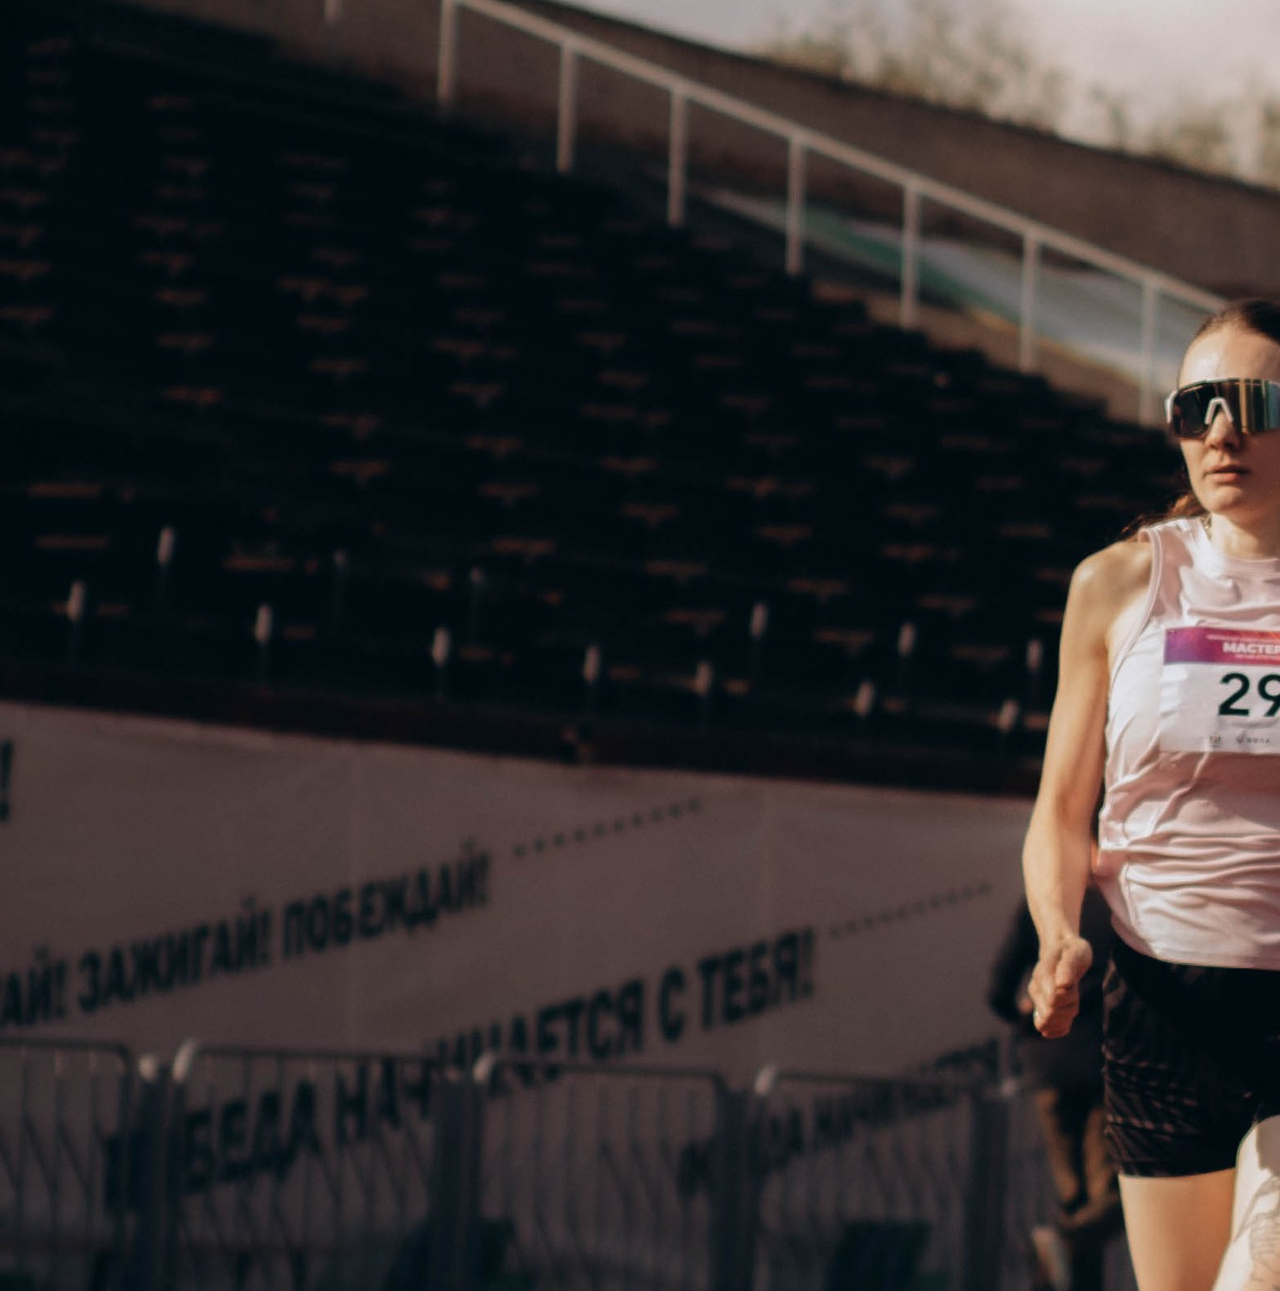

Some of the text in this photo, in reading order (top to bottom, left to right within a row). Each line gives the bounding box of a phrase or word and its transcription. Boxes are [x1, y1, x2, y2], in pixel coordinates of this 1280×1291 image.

[78, 894, 272, 1013] ЗАЖИГАЙ!
[282, 836, 491, 958] ПОБЕЖДАЙ!
[697, 926, 815, 1031] ТЕБЯ!
